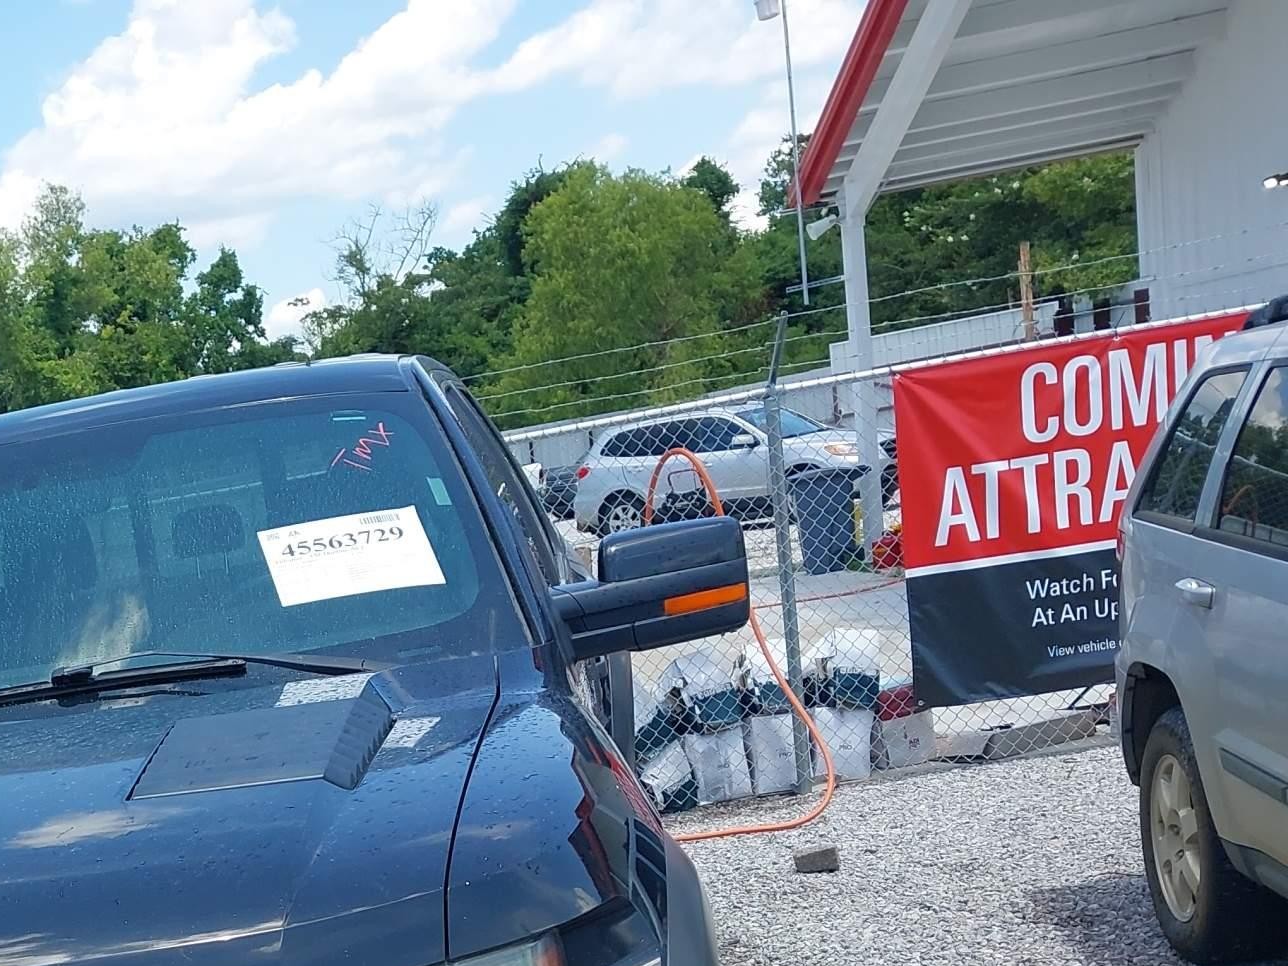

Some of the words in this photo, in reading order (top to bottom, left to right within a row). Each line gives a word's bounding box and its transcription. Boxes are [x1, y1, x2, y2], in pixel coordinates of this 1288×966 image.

[281, 525, 405, 558] 45563729
[1026, 572, 1094, 600] Watch
[1032, 606, 1056, 628] At
[1060, 602, 1088, 624] An
[1047, 644, 1075, 658] View
[1077, 638, 1117, 654] vehicle
